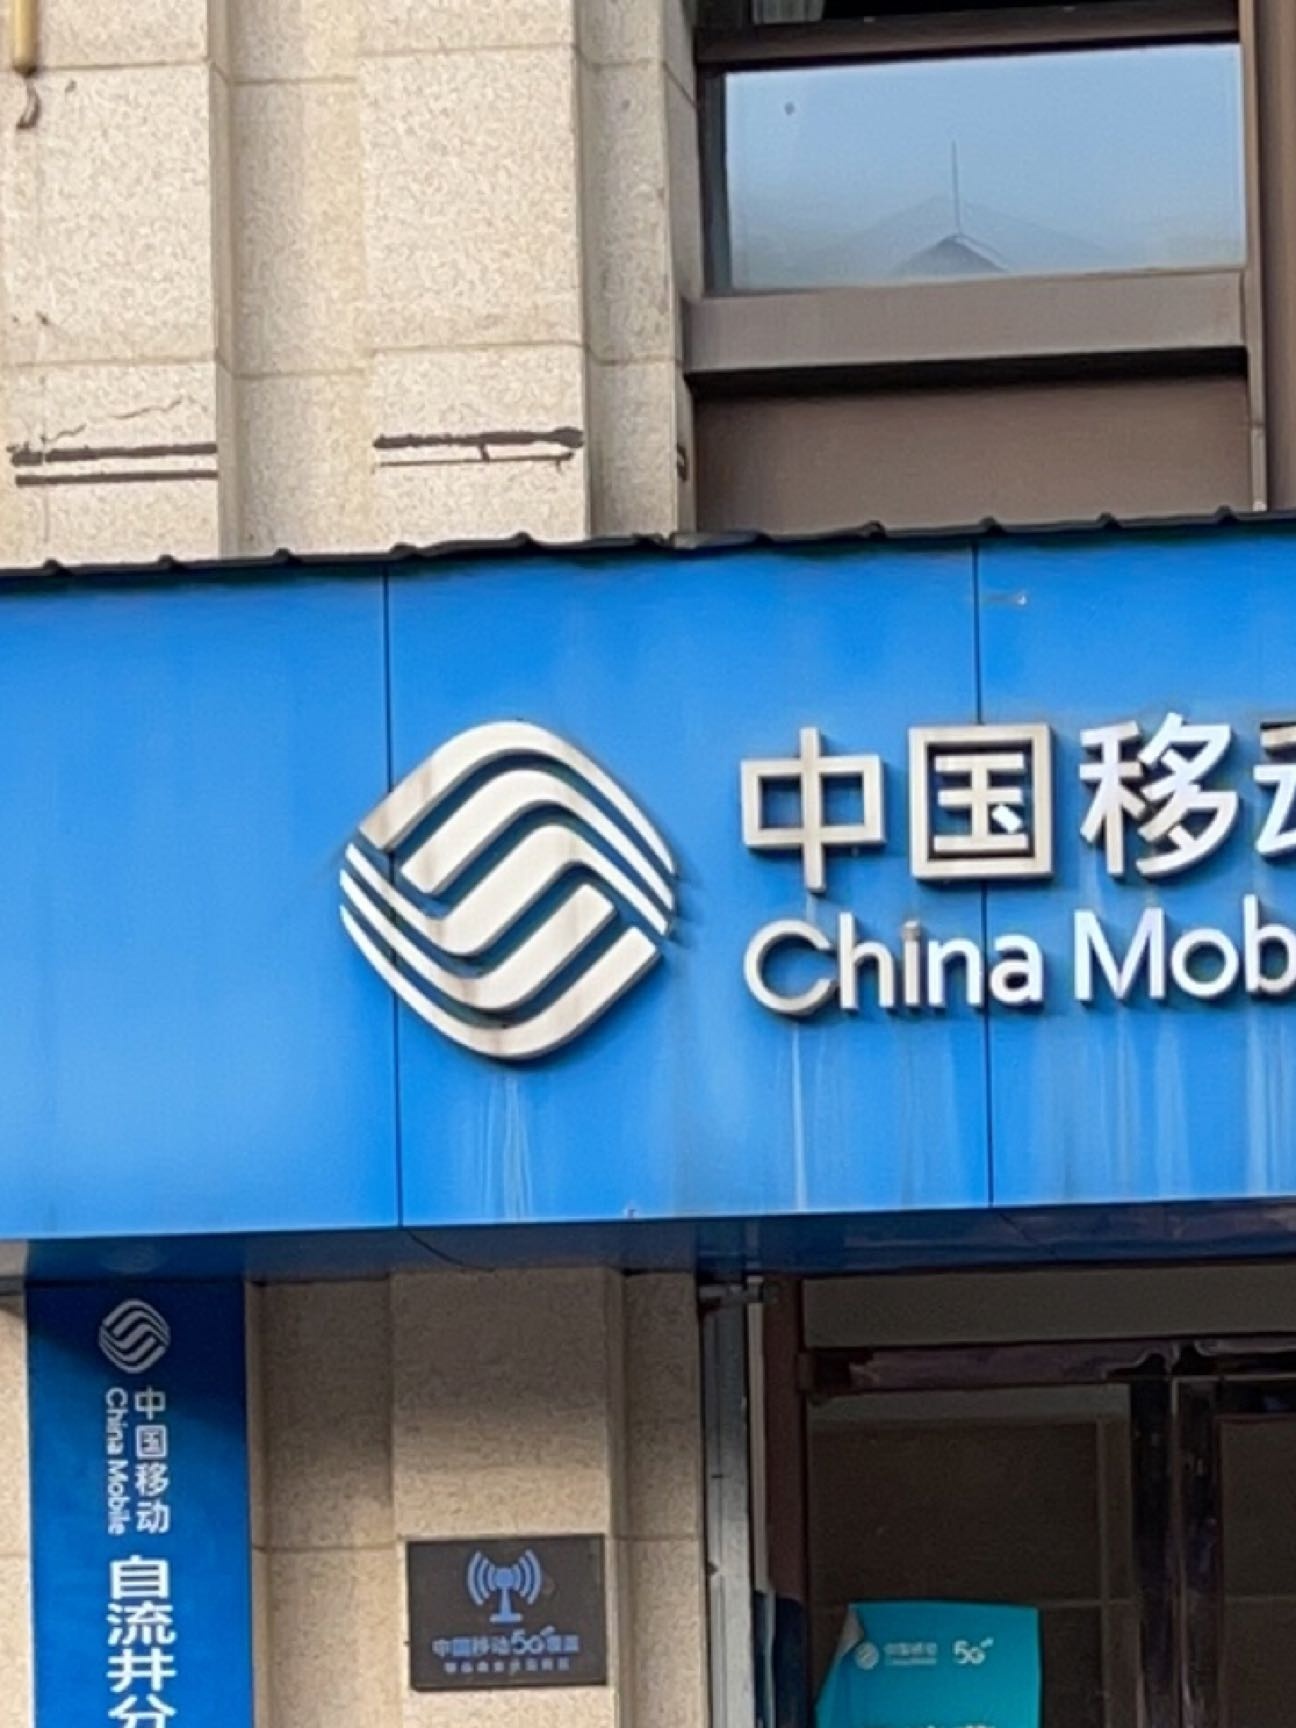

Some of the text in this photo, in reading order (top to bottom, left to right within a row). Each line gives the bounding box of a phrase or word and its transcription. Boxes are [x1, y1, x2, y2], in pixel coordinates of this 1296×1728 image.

[742, 909, 1045, 1017] China
[105, 1387, 131, 1536] China Mobile
[134, 1386, 171, 1534] 中国移动
